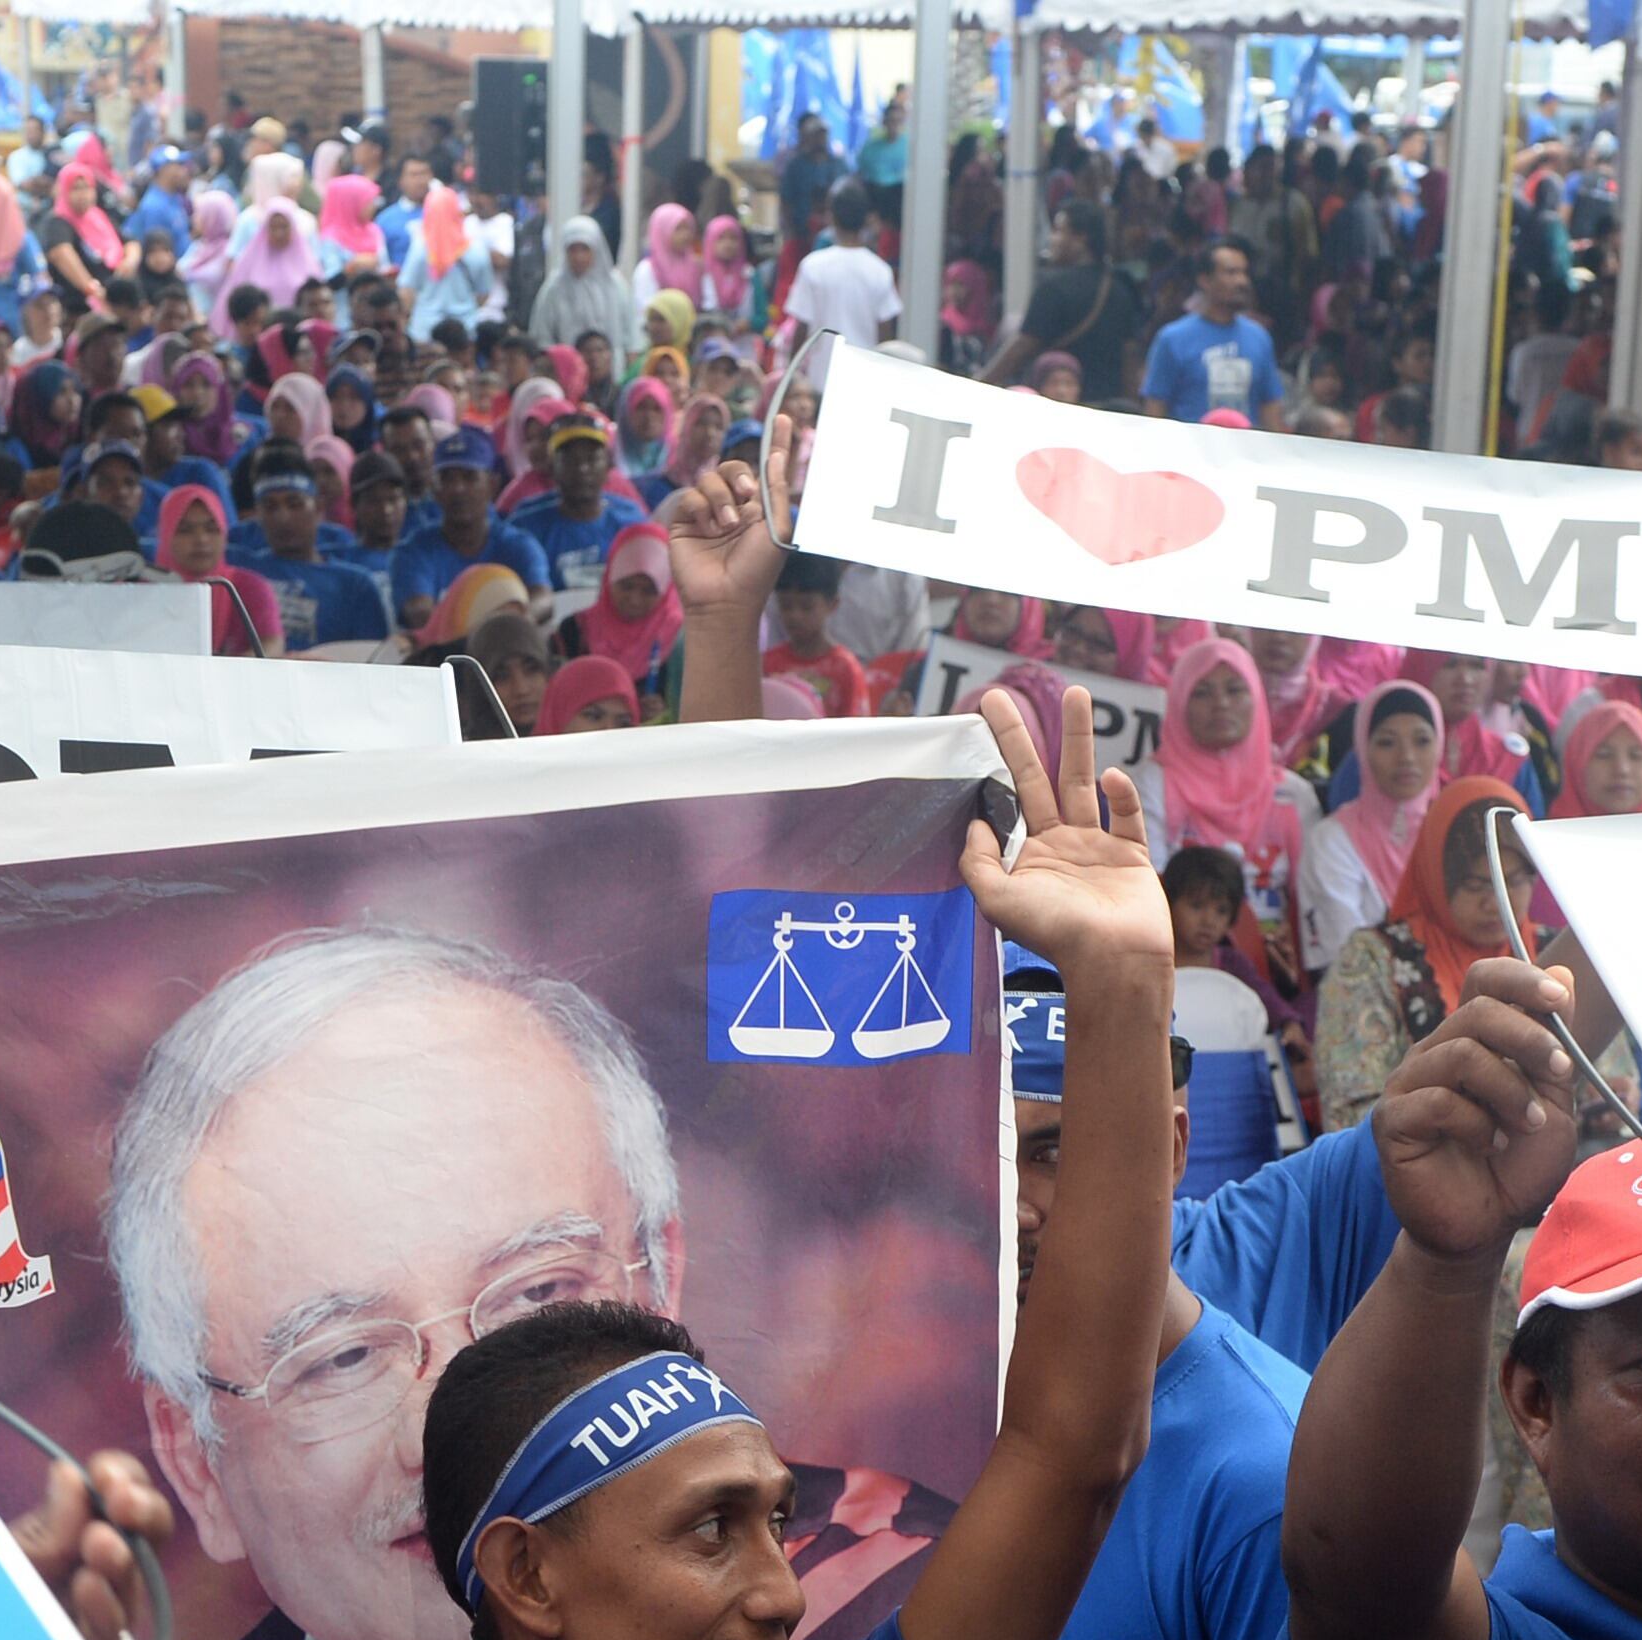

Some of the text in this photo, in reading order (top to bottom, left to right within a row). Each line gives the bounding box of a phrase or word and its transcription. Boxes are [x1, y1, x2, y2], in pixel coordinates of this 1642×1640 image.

[873, 407, 1641, 636] I PM
[569, 1372, 696, 1467] TUAH
